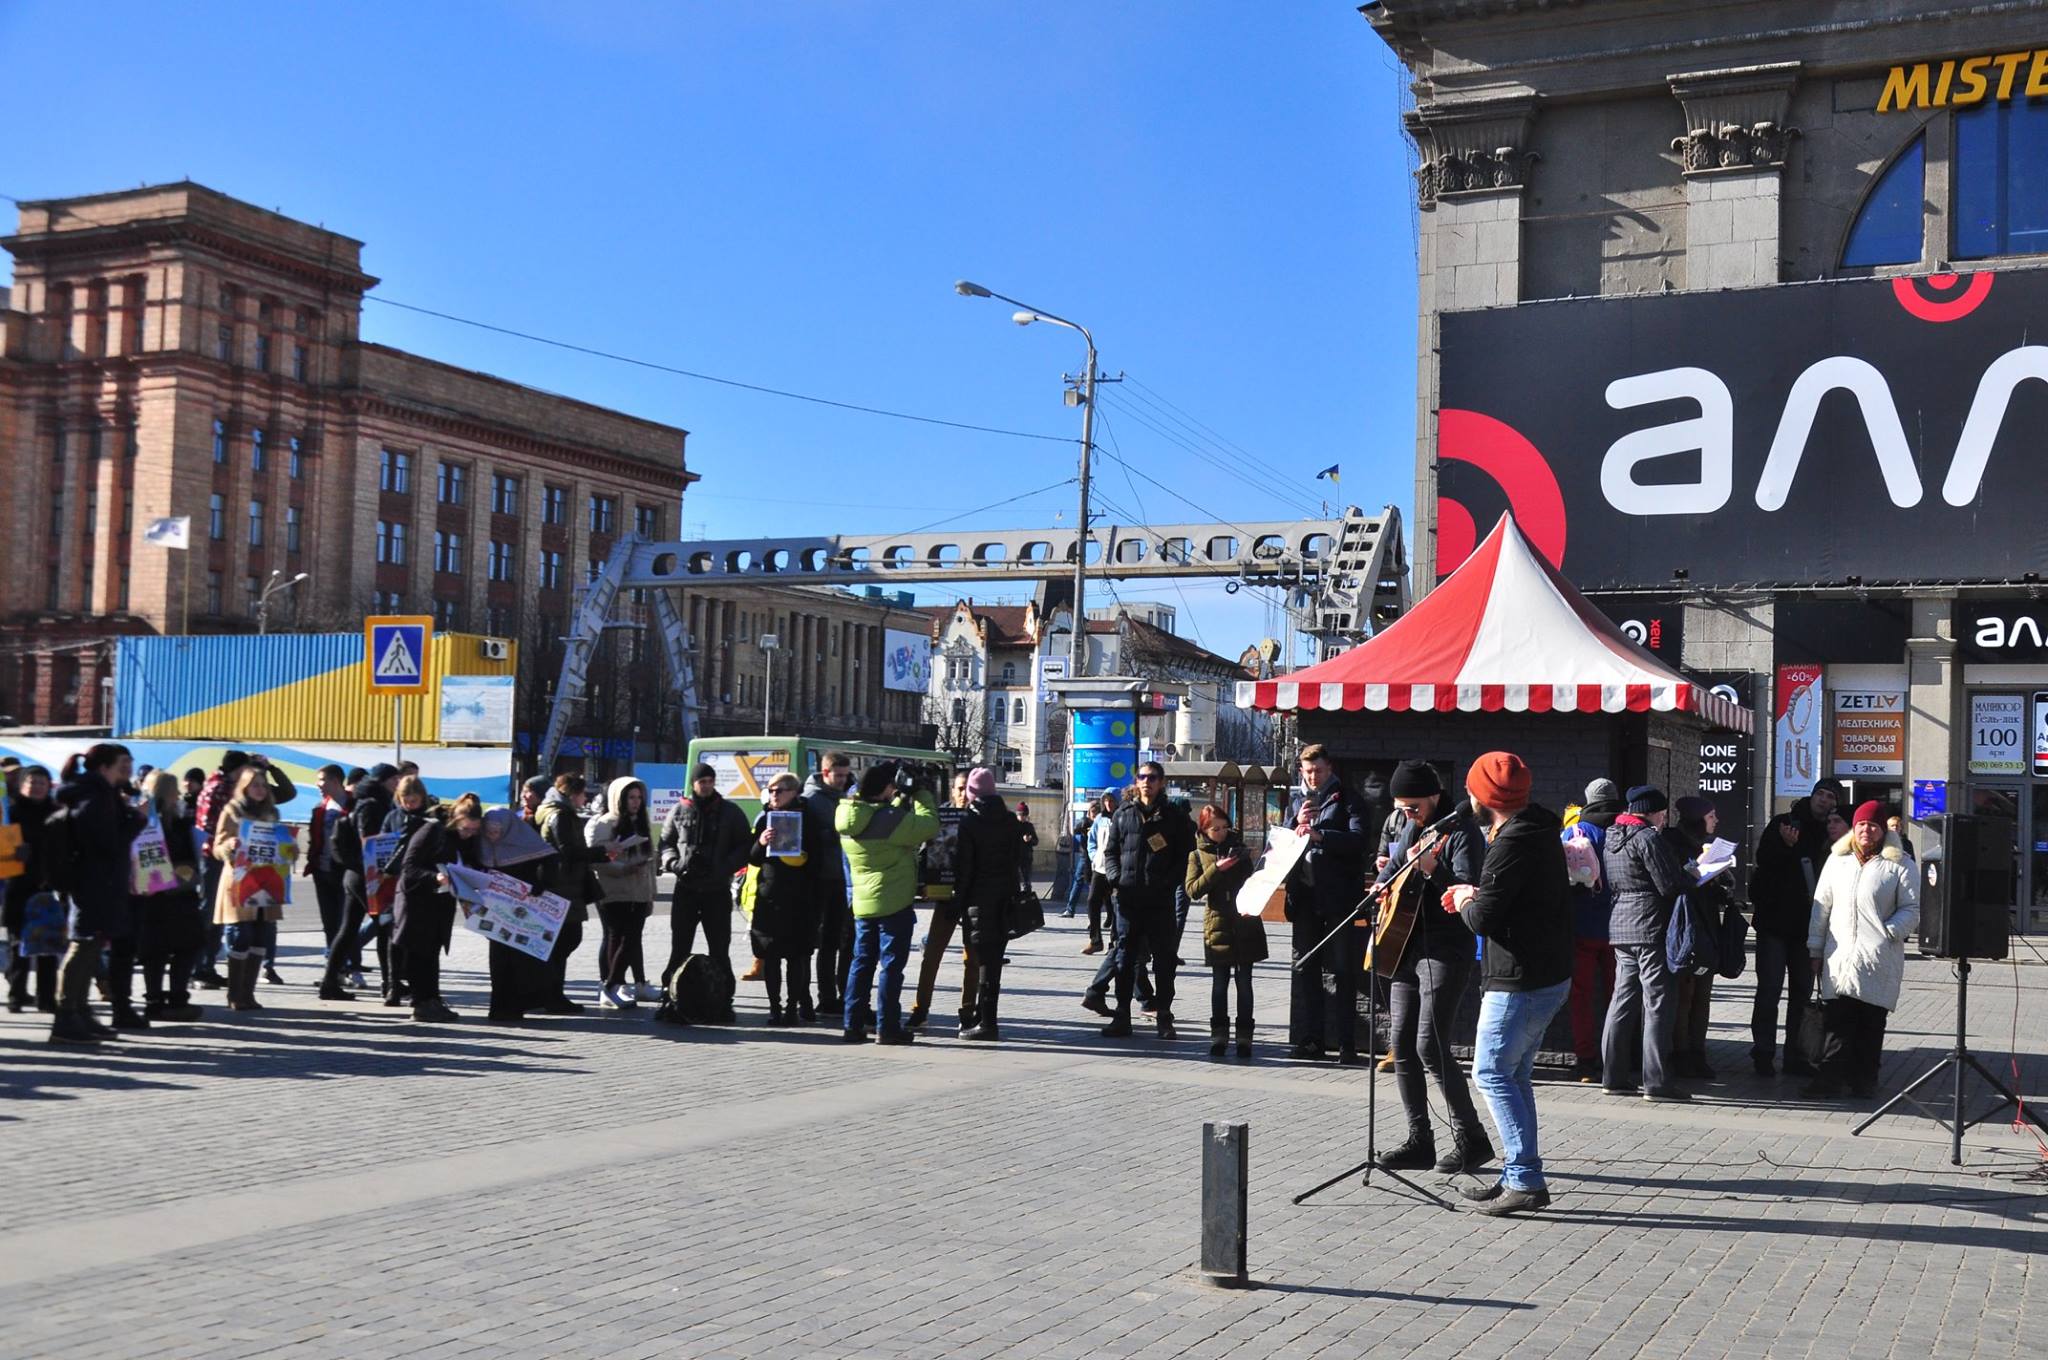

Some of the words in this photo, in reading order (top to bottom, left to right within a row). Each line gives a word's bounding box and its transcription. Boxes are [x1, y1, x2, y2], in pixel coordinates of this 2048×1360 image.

[1651, 619, 1661, 648] max
[1975, 616, 2048, 648] ал
[1837, 719, 1902, 729] МЕДТЕХНИКА
[1841, 734, 1876, 743] ТОВАРЫ
[1878, 734, 1897, 743] ДЛЯ
[1976, 728, 2017, 747] 100
[1843, 744, 1895, 753] ЗДОРОВЬЯ
[1851, 764, 1859, 773] 3
[1862, 765, 1886, 773] ЭТАЖ
[248, 845, 276, 858] БЕЗ
